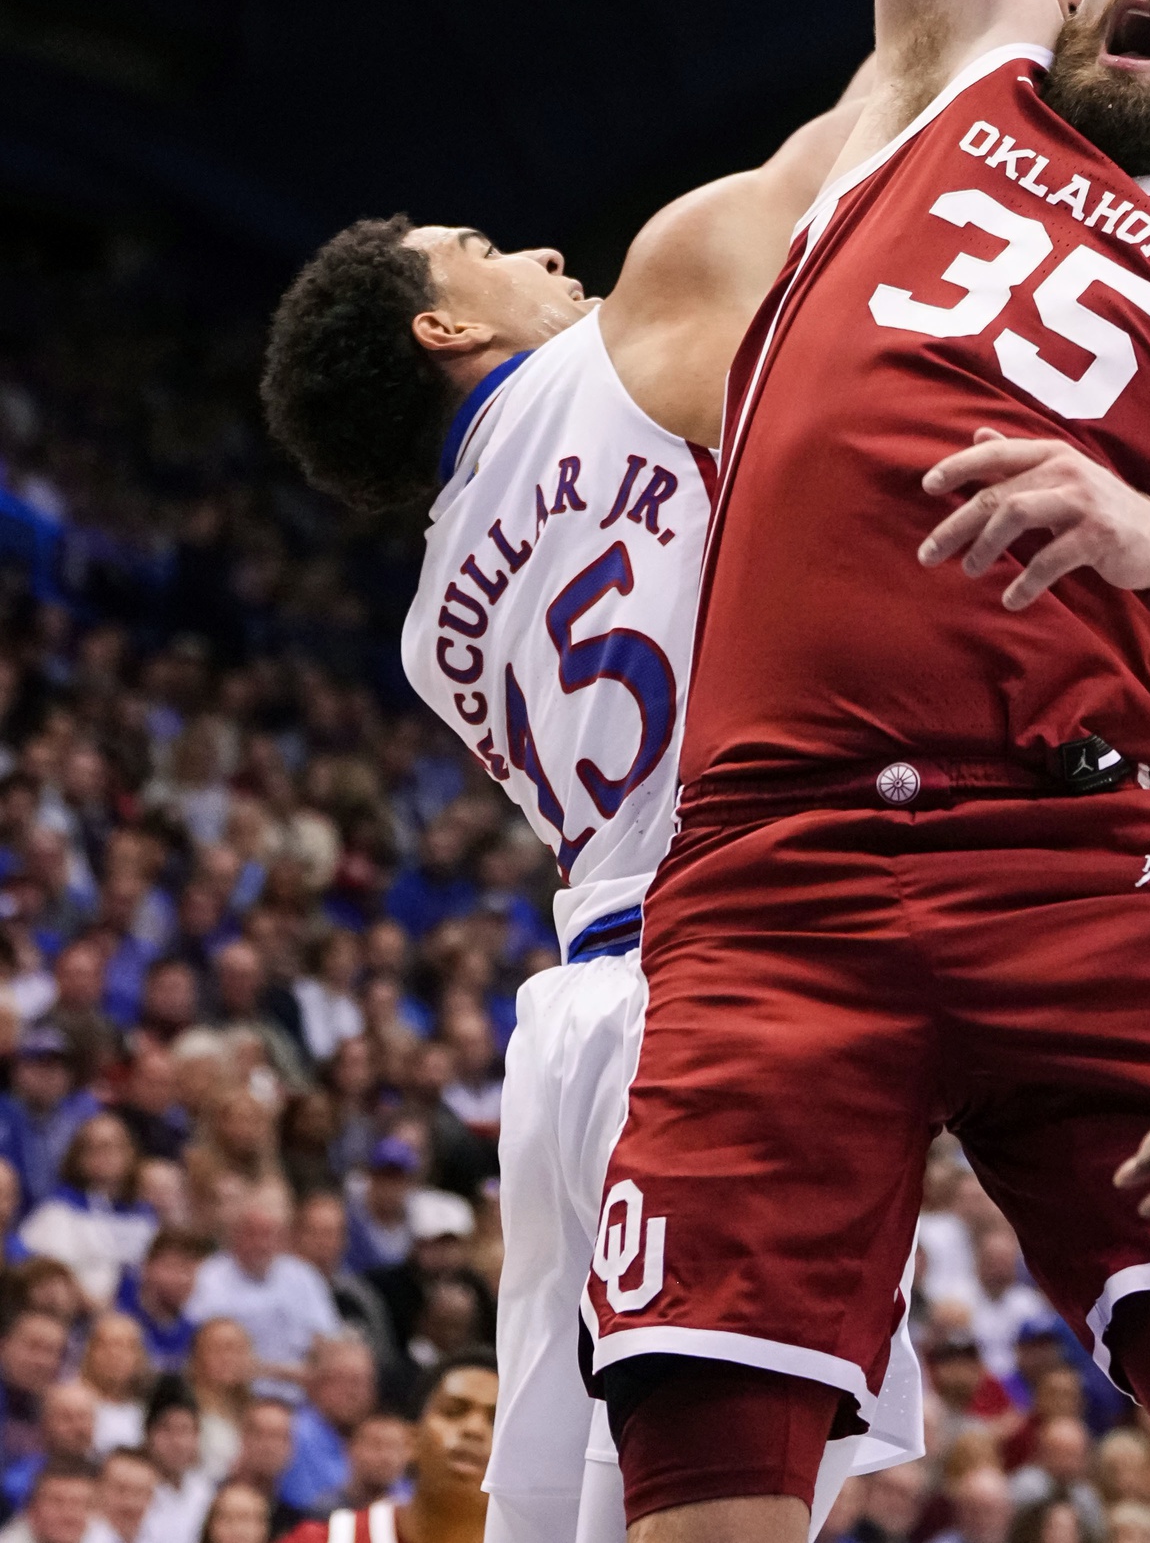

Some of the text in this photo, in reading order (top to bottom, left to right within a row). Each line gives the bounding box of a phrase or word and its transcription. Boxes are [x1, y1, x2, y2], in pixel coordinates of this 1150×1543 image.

[600, 454, 676, 547] JR.
[505, 540, 677, 885] 15
[592, 1178, 667, 1315] OU
